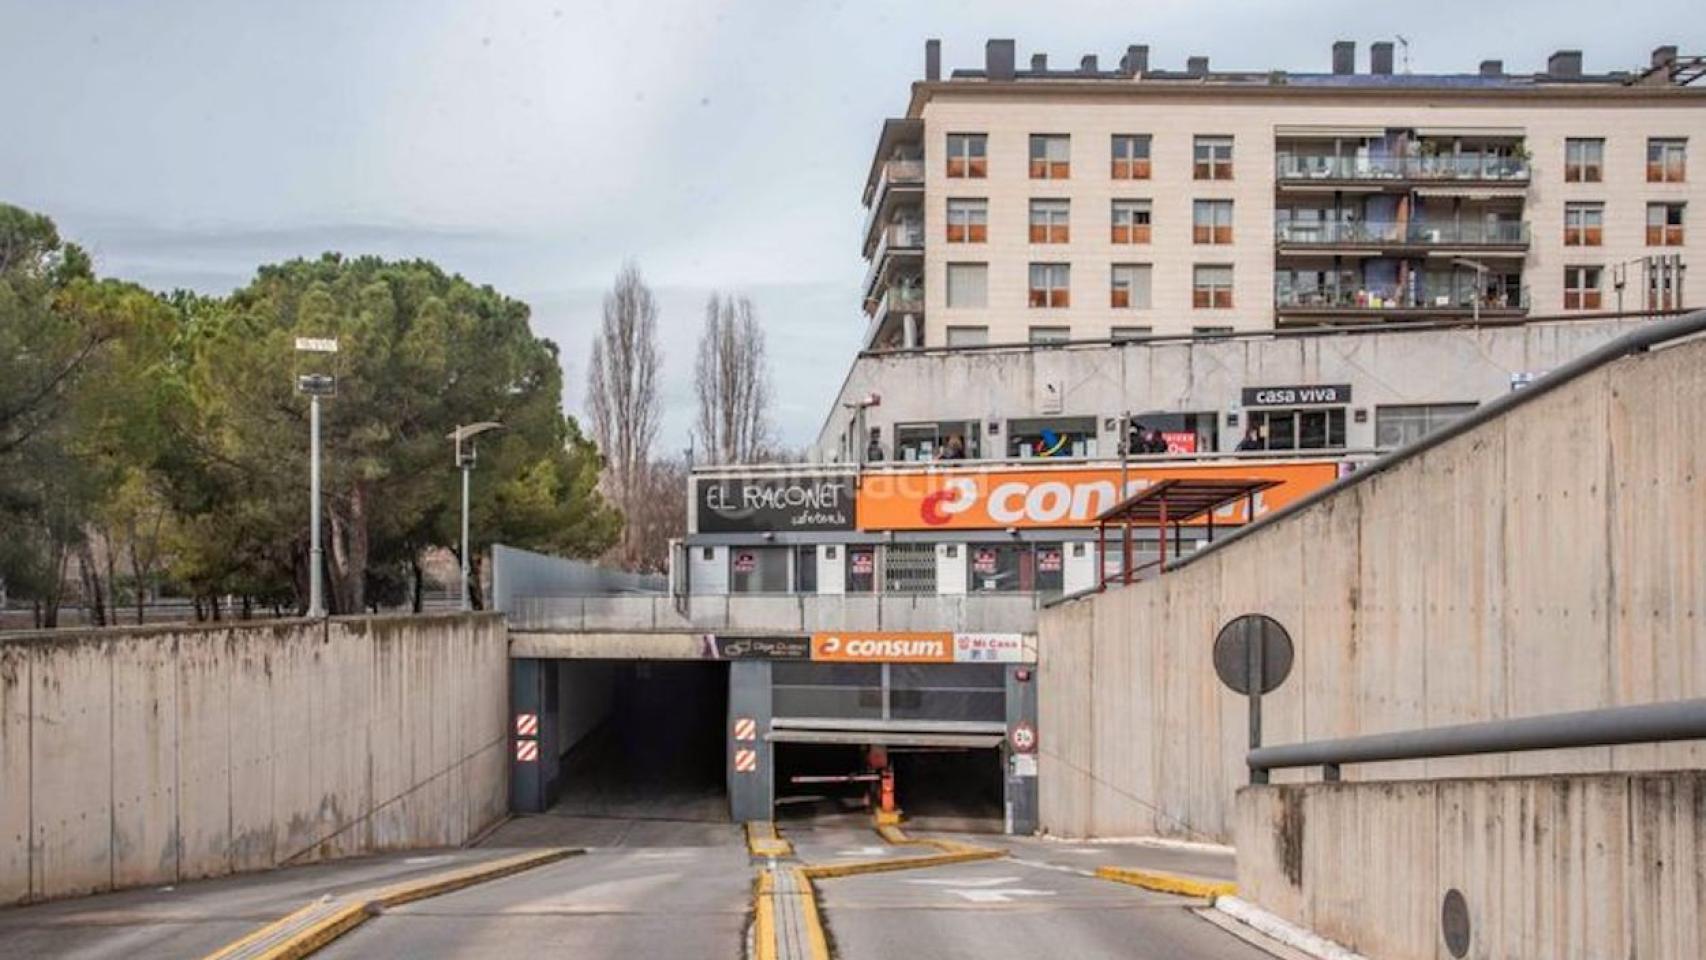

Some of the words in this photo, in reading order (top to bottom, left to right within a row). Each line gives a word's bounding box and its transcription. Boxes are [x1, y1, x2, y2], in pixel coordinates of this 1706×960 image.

[1256, 389, 1295, 404] casa
[1299, 387, 1337, 402] viva
[706, 484, 736, 509] EL
[743, 482, 846, 510] RACONET
[845, 638, 944, 658] consum
